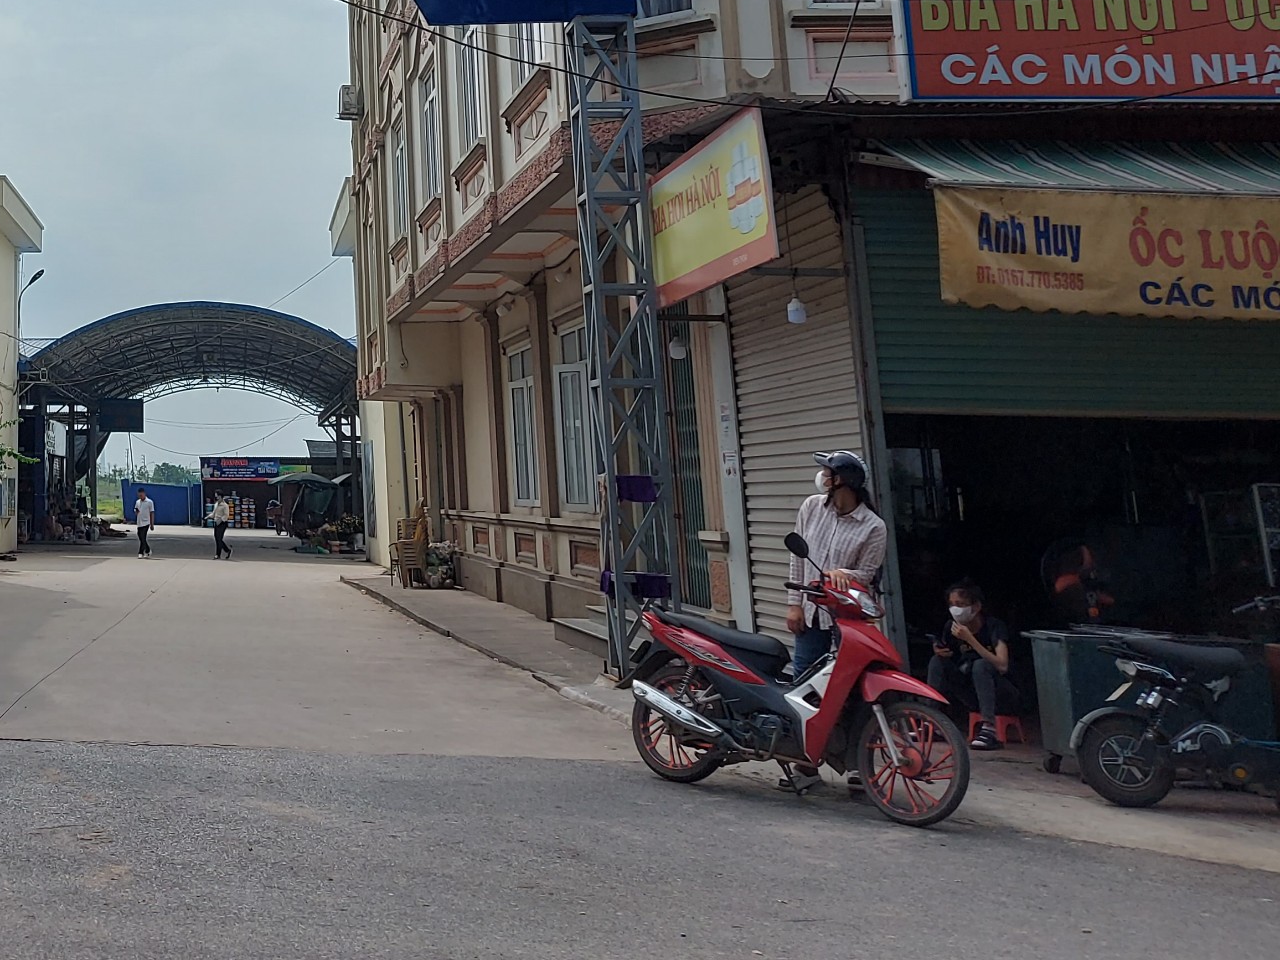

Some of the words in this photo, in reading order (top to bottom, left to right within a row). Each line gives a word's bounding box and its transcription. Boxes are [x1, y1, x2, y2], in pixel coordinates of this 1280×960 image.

[940, 45, 1048, 85] CÁC
[1063, 45, 1176, 85] MÓN
[685, 174, 702, 216] HÀ
[700, 164, 722, 209] NỘI
[977, 211, 1027, 256] Anh
[1033, 215, 1082, 263] Huy
[1128, 206, 1185, 268] ỐC
[1197, 219, 1280, 279] LUỘ
[1139, 276, 1216, 309] CÁC
